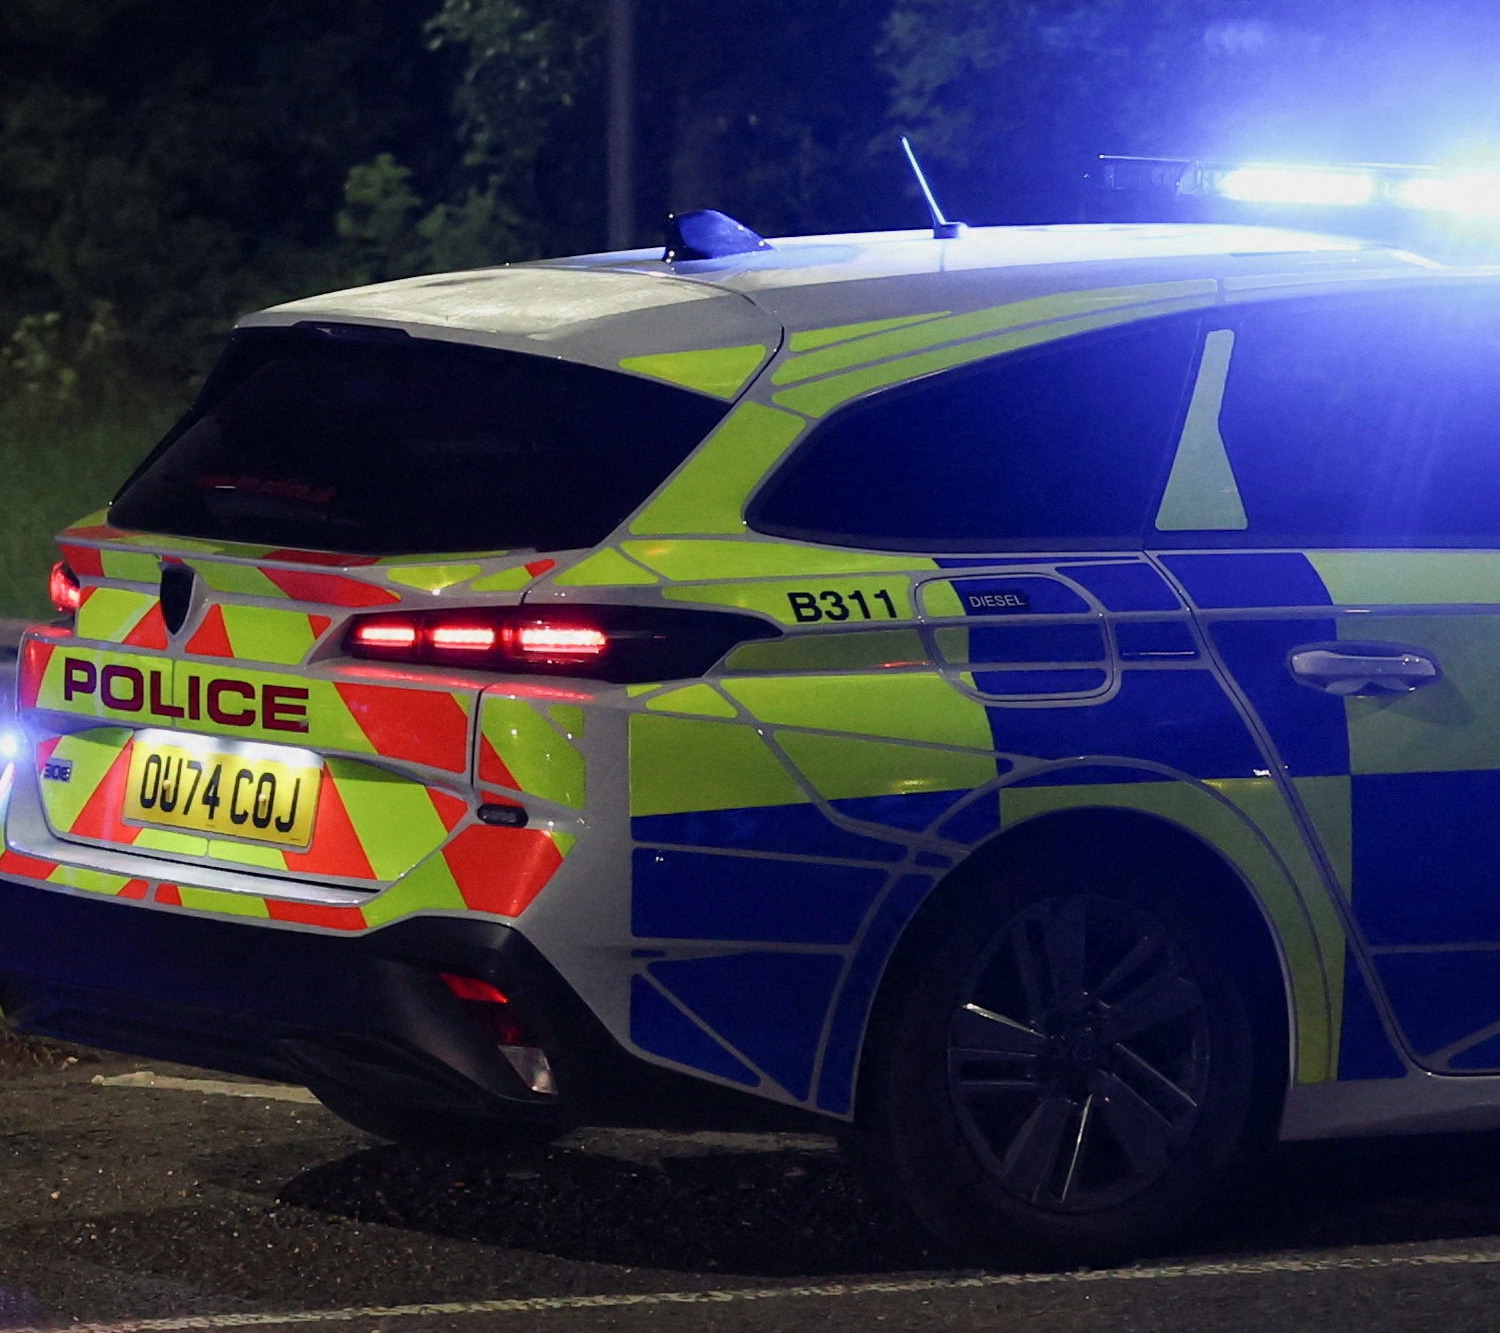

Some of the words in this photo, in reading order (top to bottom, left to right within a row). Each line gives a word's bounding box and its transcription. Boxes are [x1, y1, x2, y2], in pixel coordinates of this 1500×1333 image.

[787, 589, 898, 623] B311
[968, 594, 1025, 608] DIESEL
[63, 657, 310, 734] POLICE
[140, 754, 223, 820] OU74
[230, 768, 301, 833] COJ
